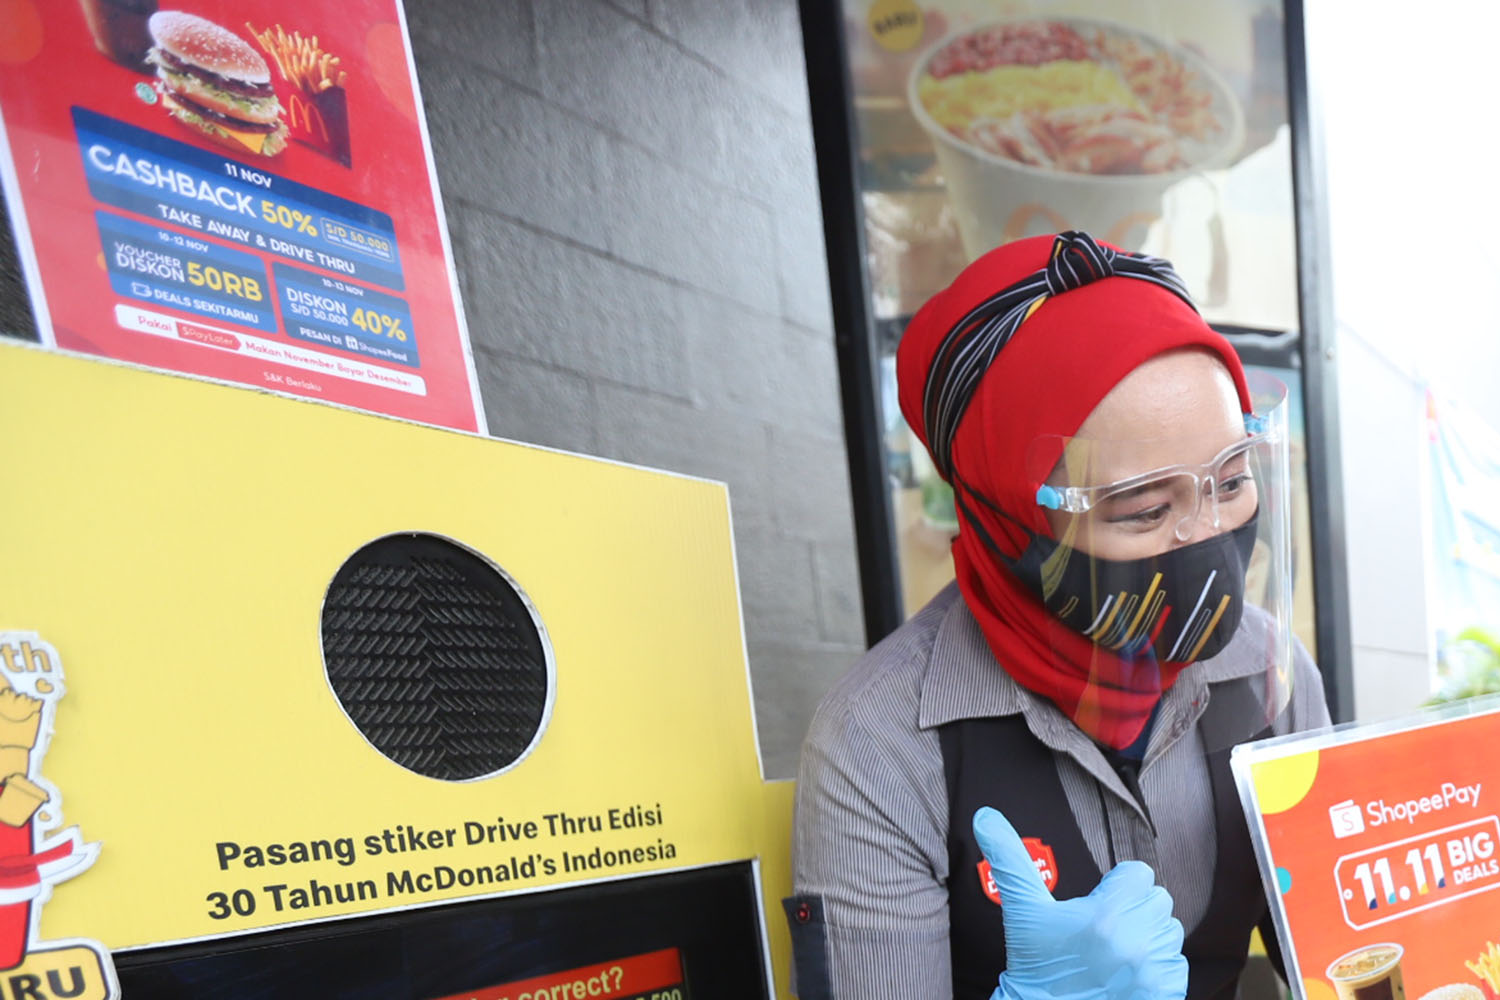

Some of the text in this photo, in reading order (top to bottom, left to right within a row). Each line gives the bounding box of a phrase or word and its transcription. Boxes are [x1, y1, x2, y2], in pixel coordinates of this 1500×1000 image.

[88, 144, 318, 237] CASHBACK 50%
[224, 162, 272, 188] 11 NOV
[113, 241, 182, 269] VOUCHER
[157, 203, 203, 229] TAKE
[207, 220, 251, 242] AWAY
[255, 234, 267, 249] &
[269, 238, 316, 262] DRIVE
[316, 252, 356, 274] THRU
[186, 239, 209, 253] NOV
[115, 252, 263, 302] DISKON 50RB
[345, 284, 364, 297] NOV
[153, 288, 260, 324] DEALS SEKITARMU
[286, 287, 408, 342] DISKON 40%
[137, 315, 173, 332] Pakai
[245, 340, 283, 358] Makan
[283, 349, 335, 369] November
[336, 362, 366, 379] Bayar
[299, 326, 331, 345] PESAN
[331, 334, 343, 346] DI
[1366, 781, 1482, 827] ShopeePay
[215, 802, 664, 871] Pasang stiker Drive Thru Edisi
[1446, 831, 1495, 868] BIG
[204, 839, 678, 922] 30 Tahun McDonald's Indonesia
[1353, 842, 1500, 911] 11.11 DEALS
